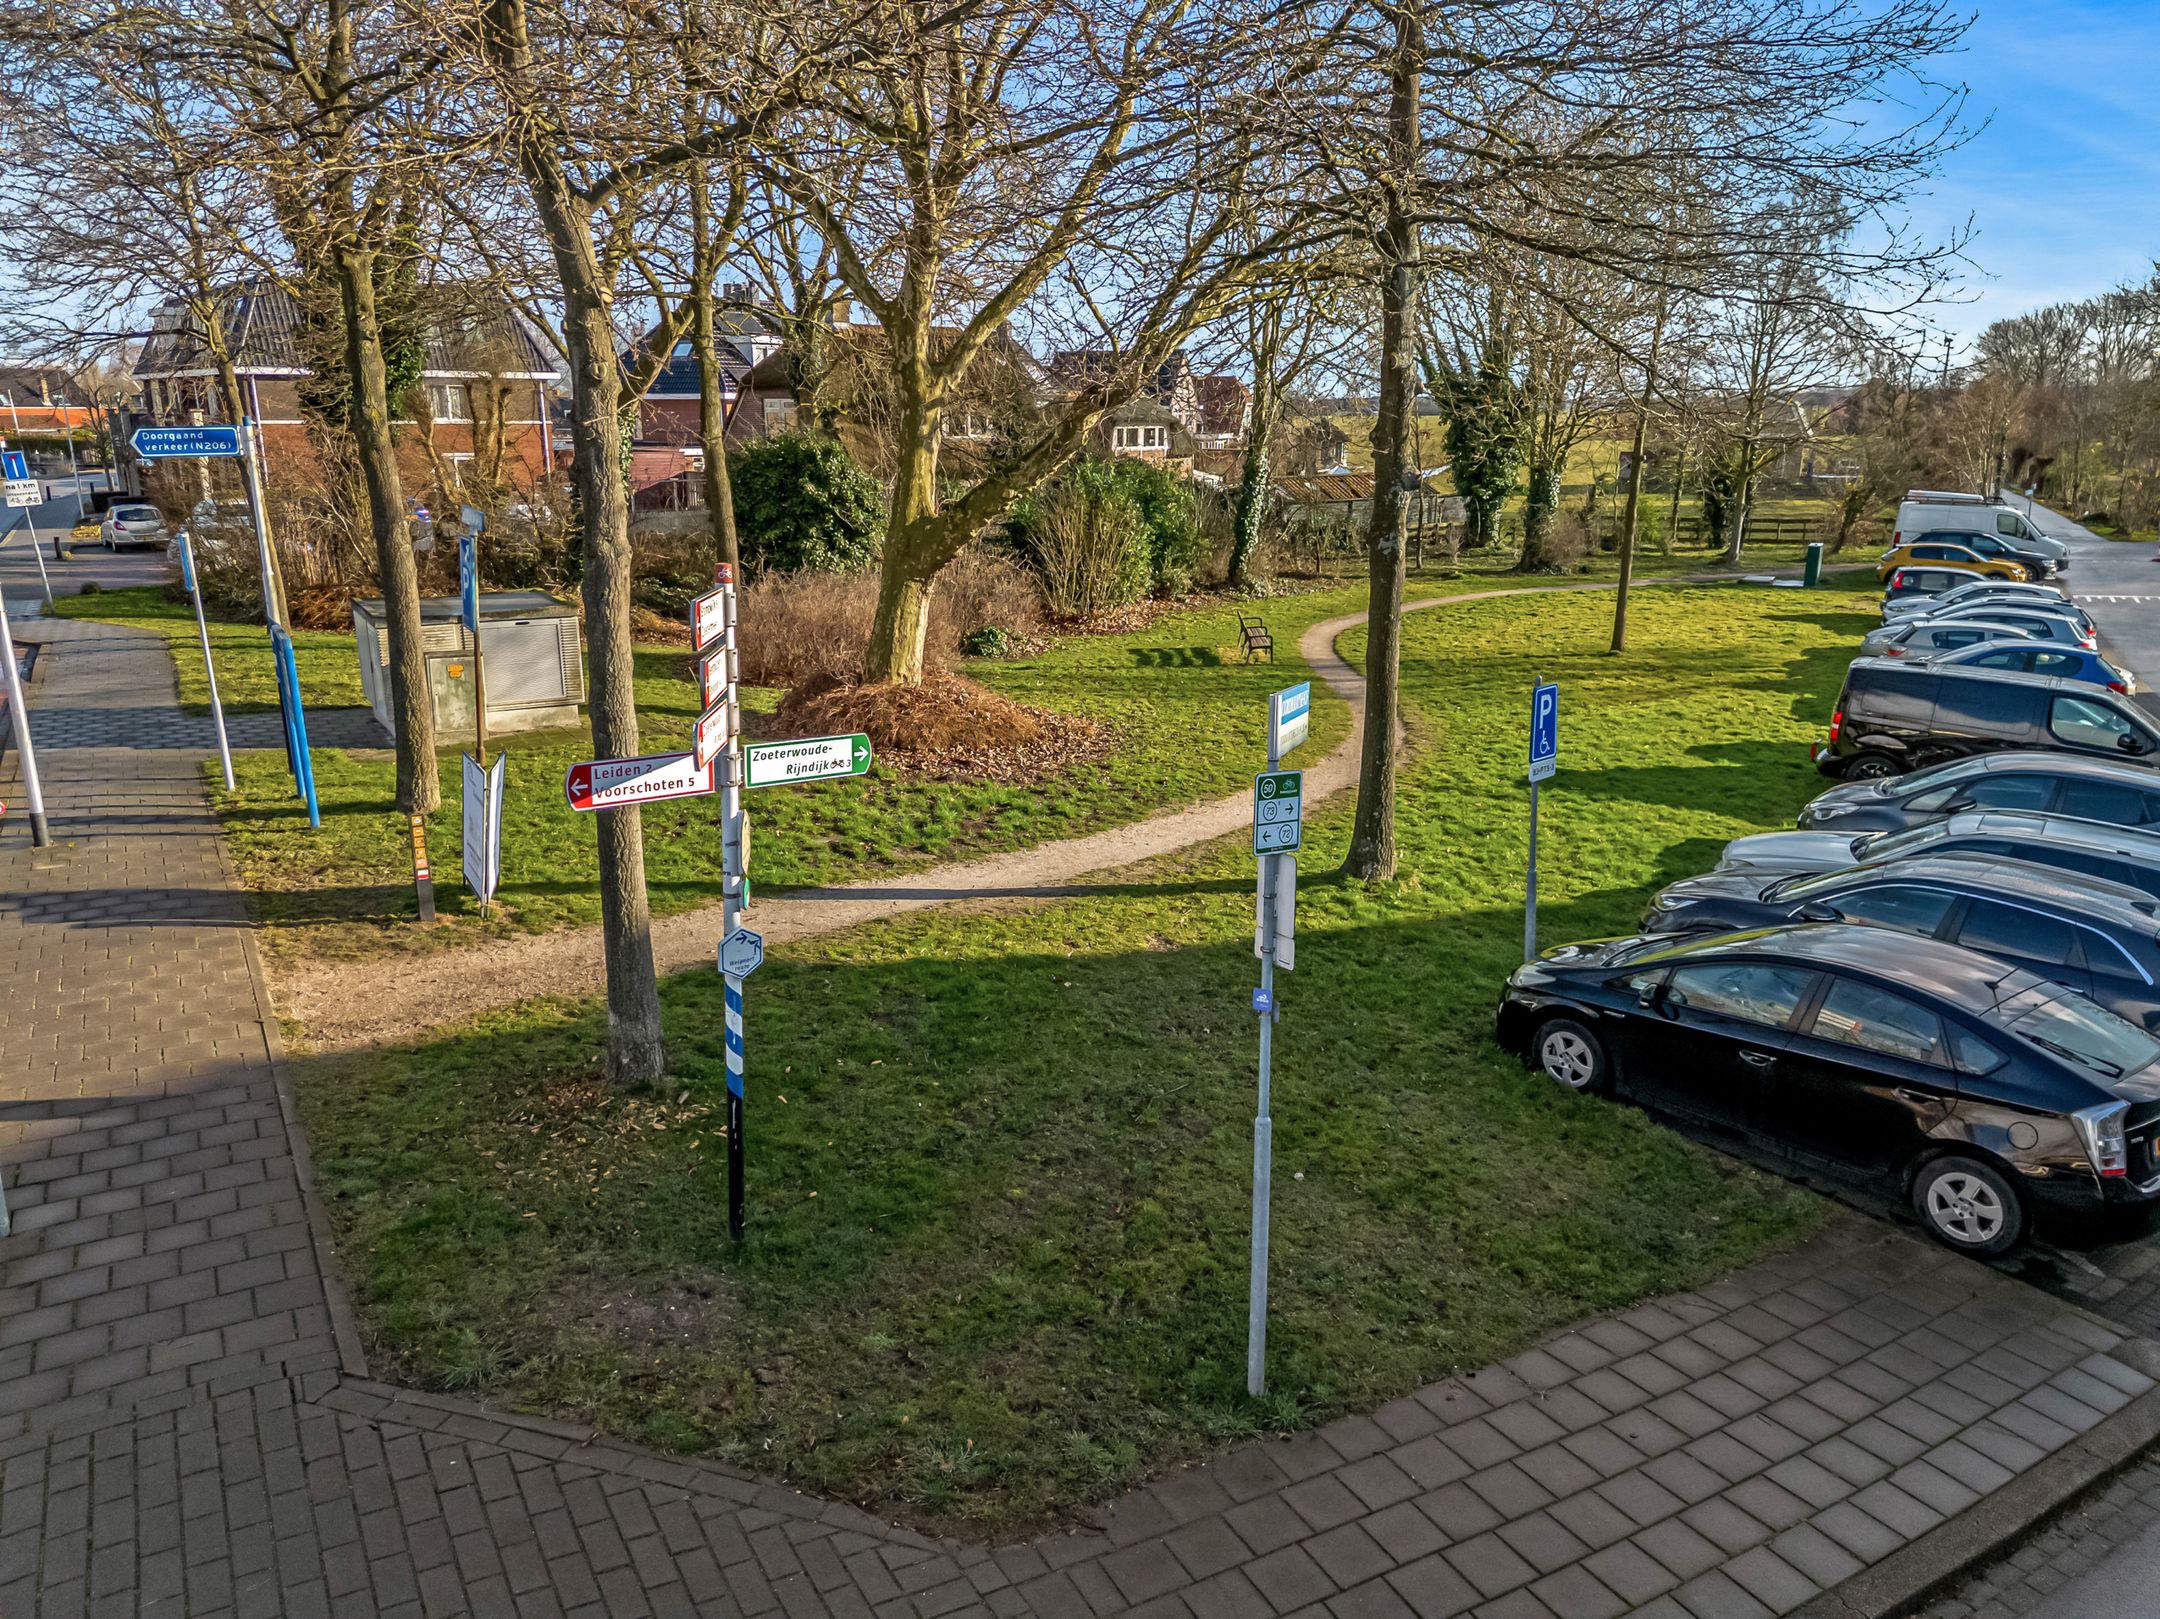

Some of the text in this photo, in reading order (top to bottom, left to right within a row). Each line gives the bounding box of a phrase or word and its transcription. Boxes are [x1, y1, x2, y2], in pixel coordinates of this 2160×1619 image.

[142, 431, 203, 442] Doorgaand
[1539, 693, 1552, 729] P
[752, 744, 833, 762] Zoeterwoude-
[594, 764, 653, 780] Leiden 2
[786, 759, 852, 776] Rijndijk 3
[595, 777, 695, 798] Voorschoten 5
[1263, 783, 1274, 793] 50
[1266, 806, 1275, 816] 73
[1282, 829, 1291, 839] 72
